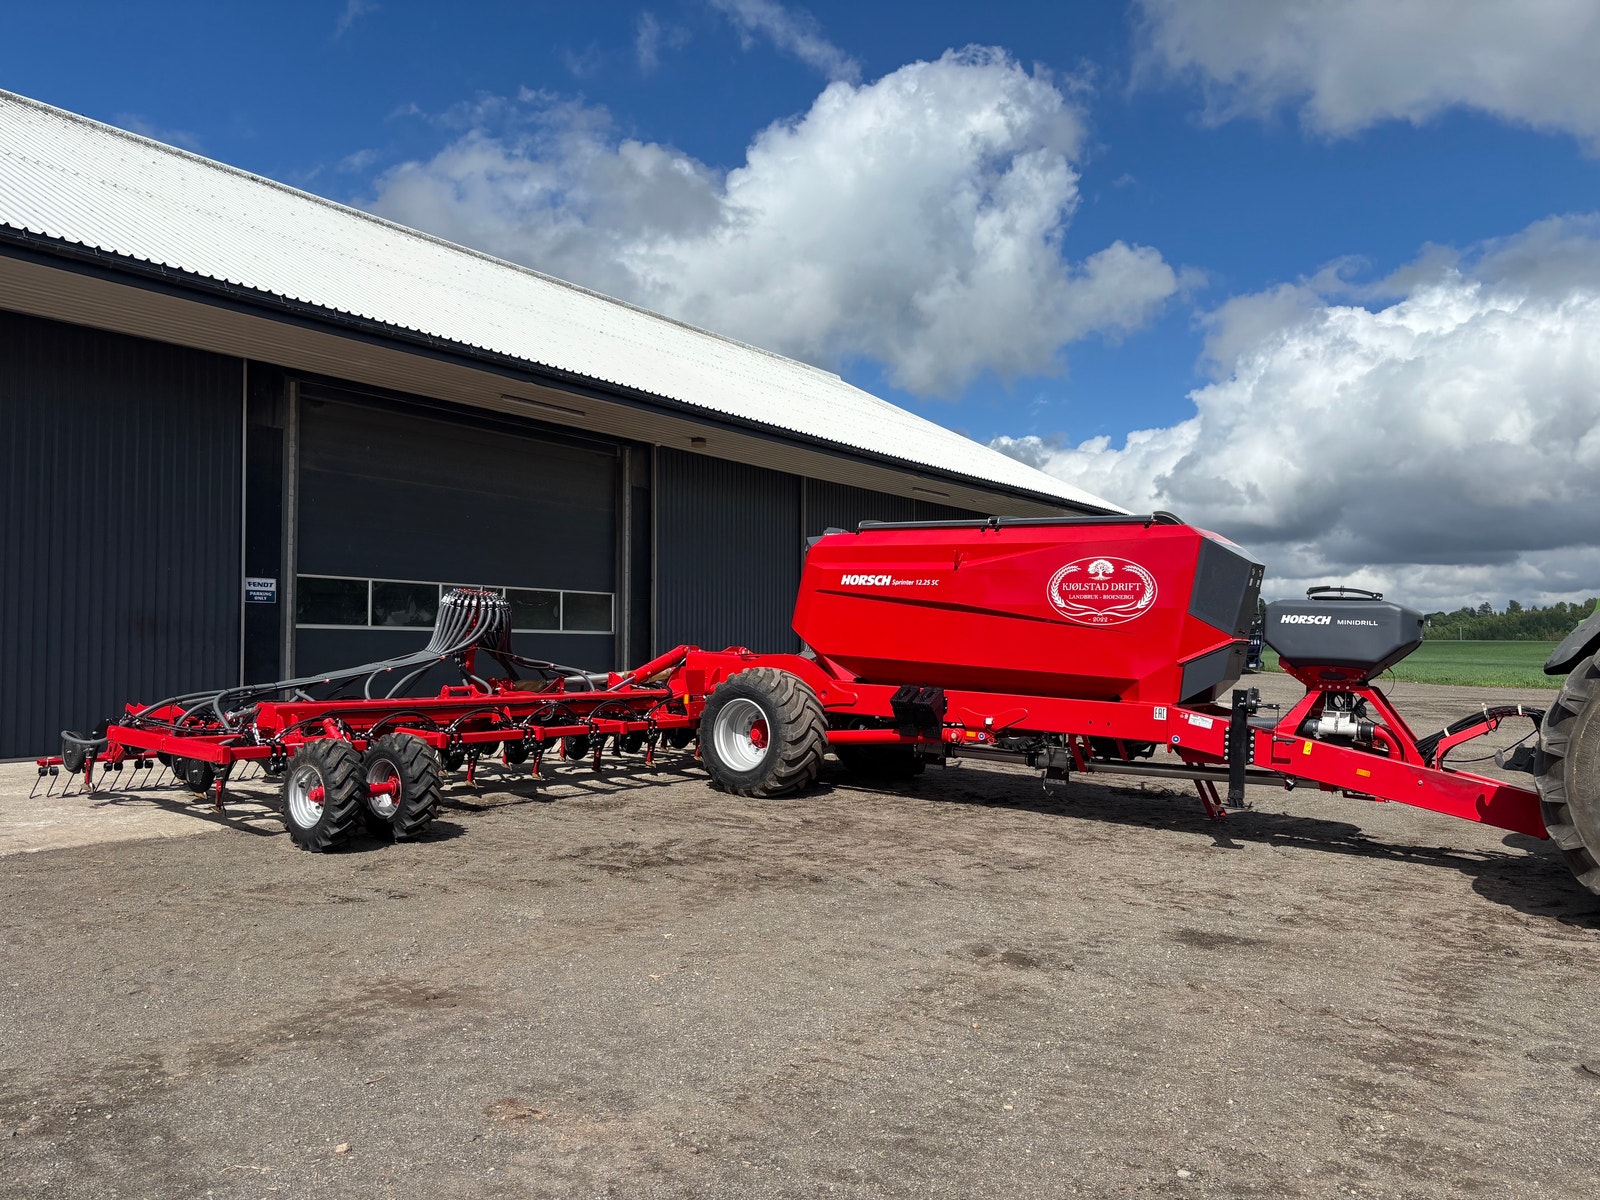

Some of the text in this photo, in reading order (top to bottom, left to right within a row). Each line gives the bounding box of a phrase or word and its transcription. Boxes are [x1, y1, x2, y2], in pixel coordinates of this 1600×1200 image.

[841, 574, 892, 586] HORSCH
[892, 579, 914, 587] Sprinter
[1062, 582, 1142, 591] KJØLSTAD DRIFT
[1280, 614, 1331, 625] HORSCH
